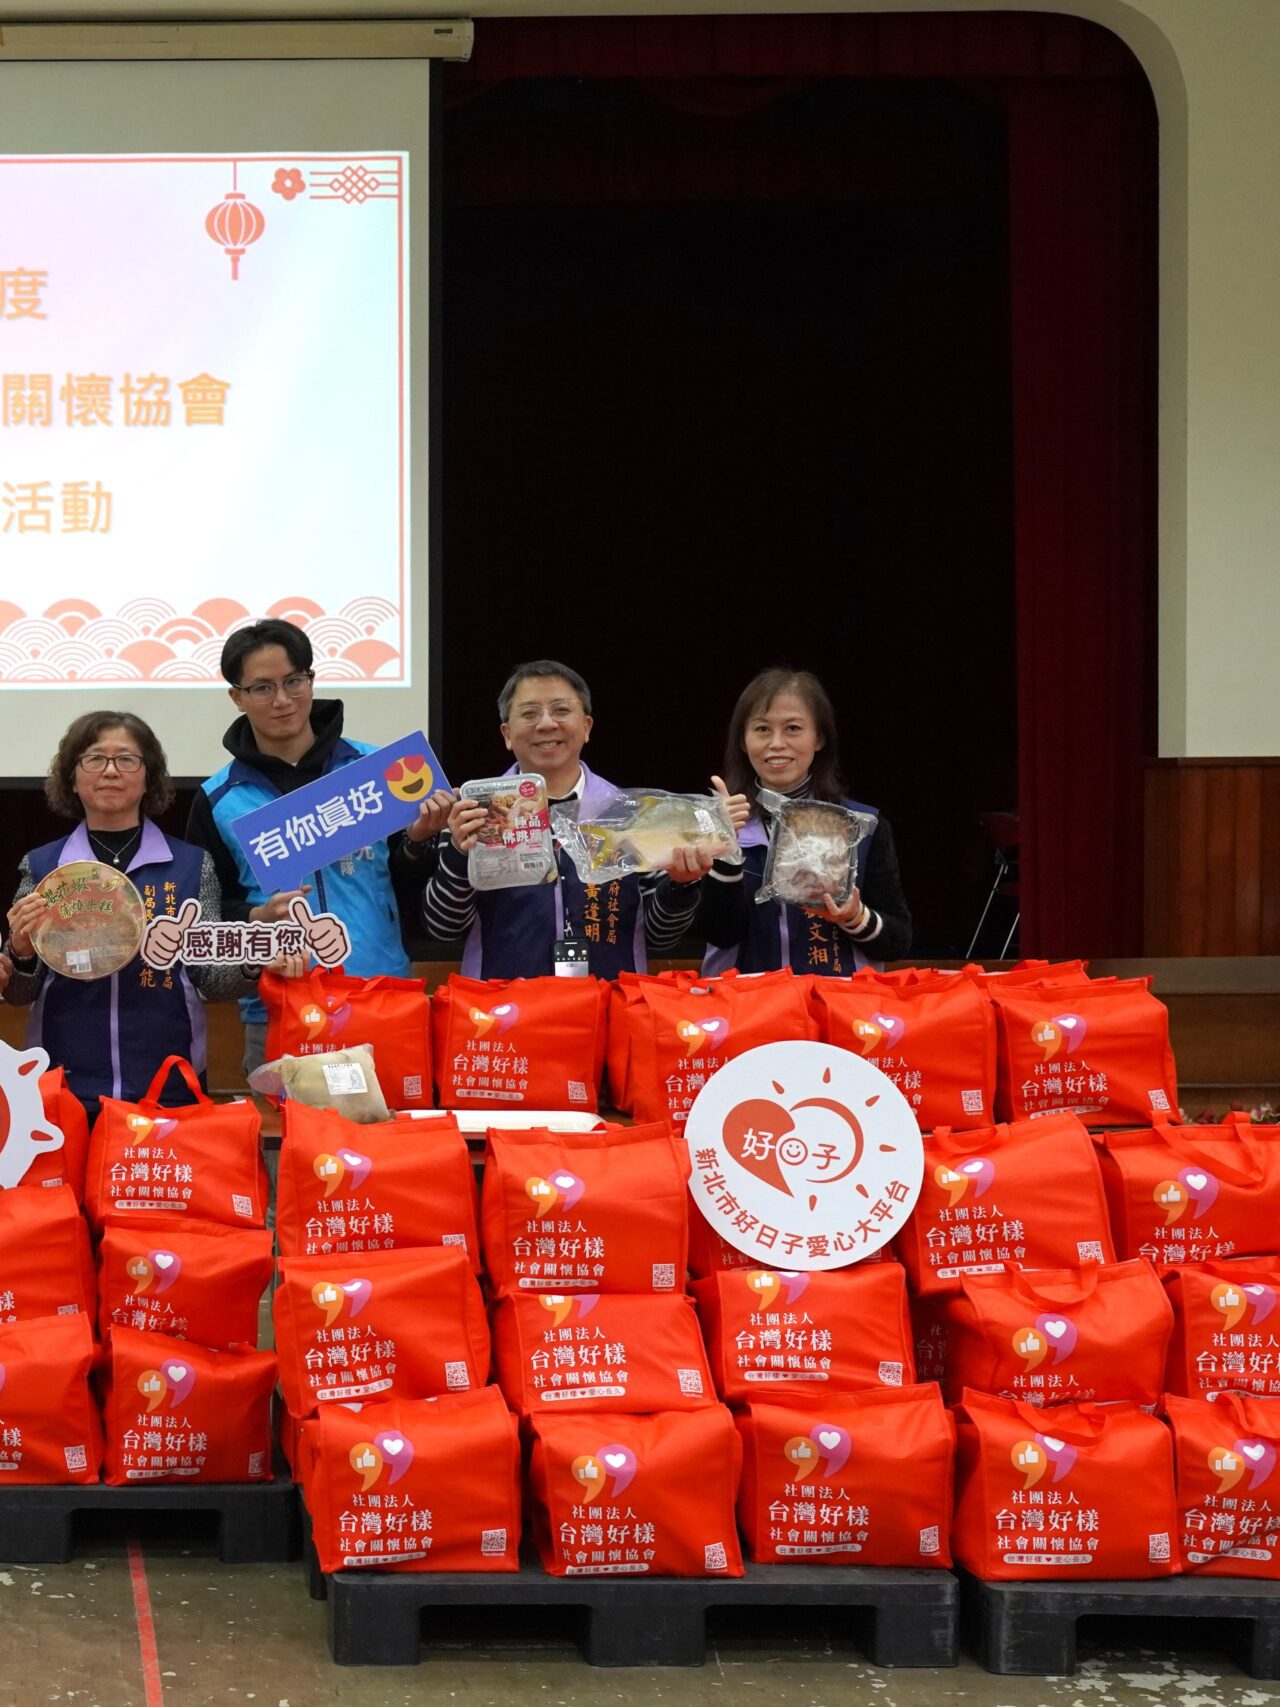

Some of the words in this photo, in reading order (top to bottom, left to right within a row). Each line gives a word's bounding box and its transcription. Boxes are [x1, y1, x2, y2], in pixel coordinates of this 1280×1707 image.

[186, 929, 305, 958] 感謝有您
[805, 910, 828, 965] 文湘
[466, 1040, 517, 1054] 社團法人
[453, 1054, 529, 1075] 台灣好樣
[1034, 1061, 1090, 1075] 社團法人
[452, 1075, 529, 1090] 社會關懷協會
[1021, 1073, 1108, 1098] 台灣好樣
[123, 1147, 178, 1160] 社團法人
[110, 1162, 193, 1184] 台灣好樣
[110, 1185, 193, 1199] 社會關懷協會
[317, 1198, 375, 1212] 社團法人
[695, 1148, 911, 1258] 新北市好日子愛心大平台
[939, 1205, 1003, 1222] 社團法人
[305, 1213, 395, 1238] 台灣好樣
[527, 1220, 587, 1233] 社團法人
[926, 1220, 1025, 1247] 台灣好樣
[1154, 1226, 1219, 1239] 社團法人
[512, 1237, 605, 1259] 台灣好樣
[930, 1246, 1026, 1265] 社會關懷協會
[514, 1261, 605, 1276] 社會關懷協會
[749, 1313, 813, 1325] 社團法人
[316, 1325, 377, 1343] 社團法人
[544, 1326, 606, 1342] 社團法人
[735, 1329, 832, 1351] 台灣好樣
[304, 1340, 396, 1369] 台灣好樣
[530, 1343, 627, 1371] 台灣好樣
[737, 1355, 831, 1369] 社會關懷協會
[1196, 1351, 1280, 1373] 台灣好
[309, 1362, 397, 1387] 社會關懷協會
[534, 1370, 628, 1387] 社會關懷協會
[1012, 1375, 1079, 1388] 社團法人
[137, 1414, 192, 1429] 社團法人
[122, 1429, 208, 1452] 台灣好樣
[122, 1453, 207, 1468] 社會關懷協會
[352, 1493, 414, 1507] 社團法人
[784, 1484, 850, 1500] 社團法人
[1011, 1490, 1080, 1505] 社團法人
[1203, 1494, 1272, 1512] 社團法人
[572, 1505, 637, 1520] 社團法人
[768, 1501, 869, 1526] 台灣好樣
[996, 1510, 1099, 1531] 台灣好樣
[338, 1510, 433, 1534] 台灣好樣
[559, 1522, 655, 1546] 台灣好樣
[770, 1527, 869, 1542] 社會關懷協會
[997, 1535, 1099, 1550] 社會關懷協會
[339, 1535, 433, 1552] 社會關懷協會
[562, 1548, 656, 1563] 社會關懷協會
